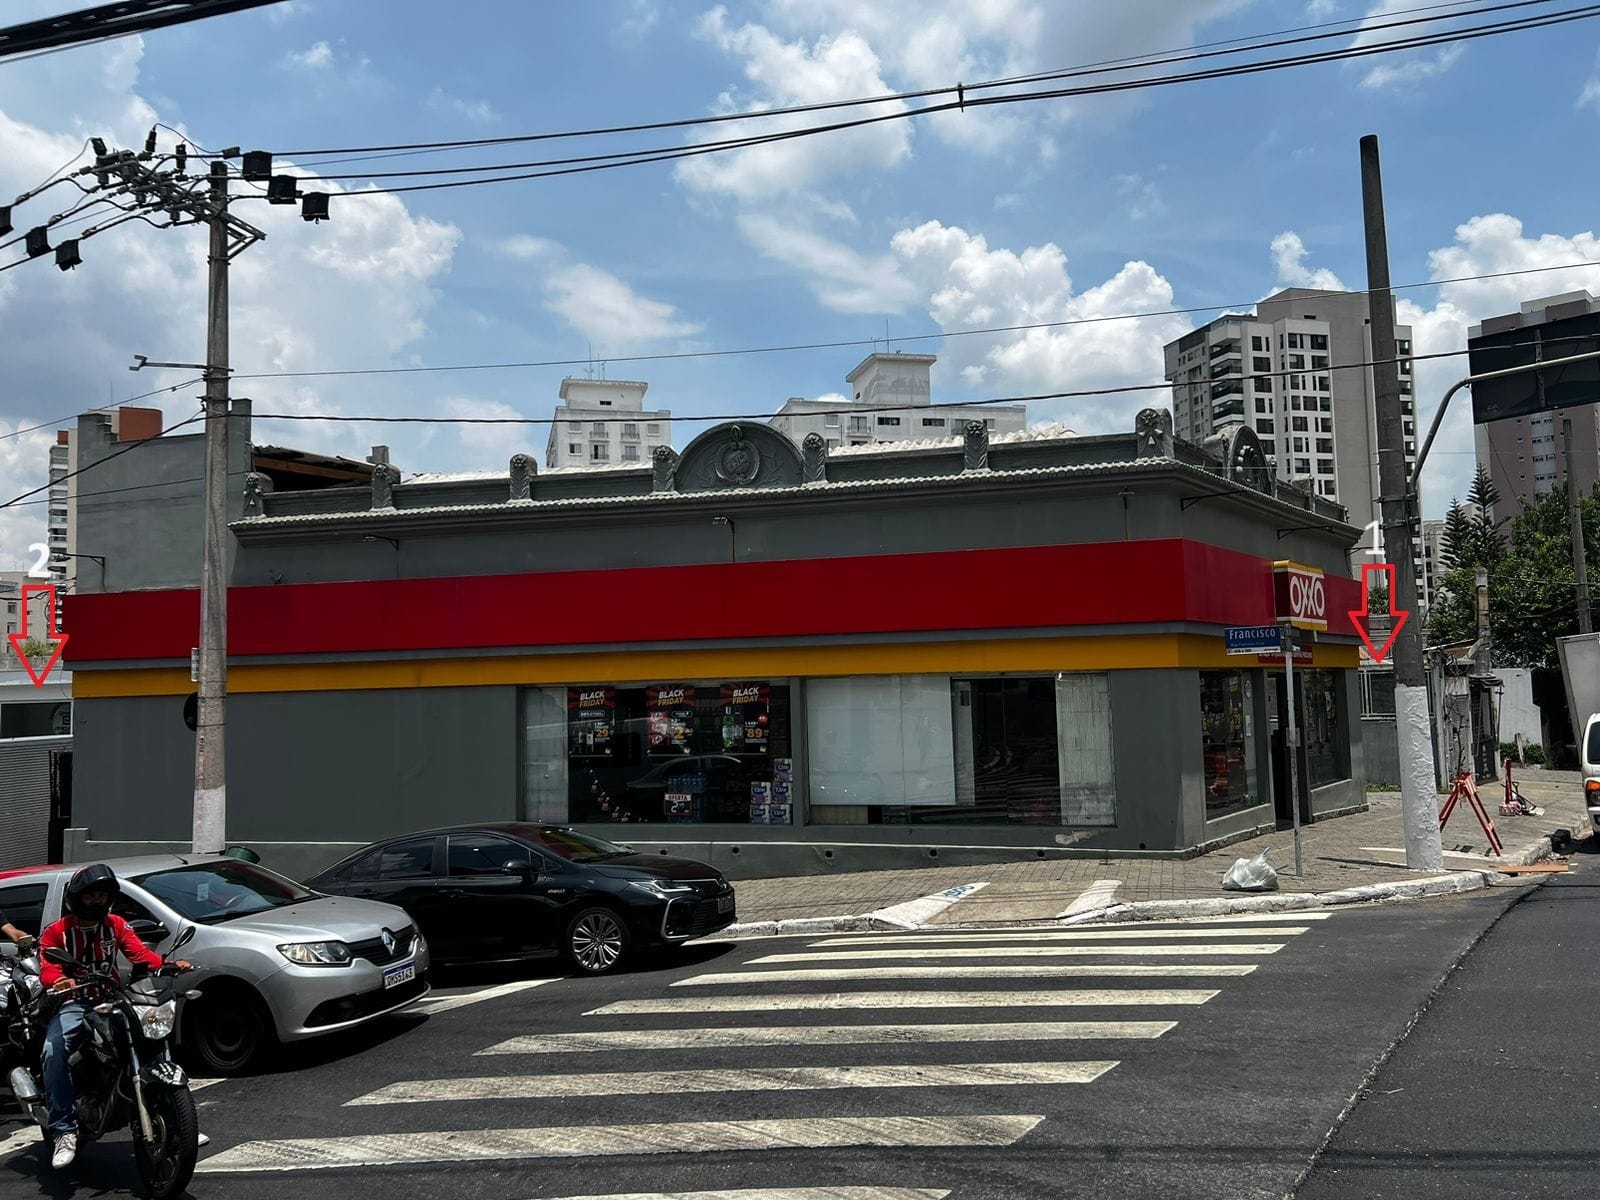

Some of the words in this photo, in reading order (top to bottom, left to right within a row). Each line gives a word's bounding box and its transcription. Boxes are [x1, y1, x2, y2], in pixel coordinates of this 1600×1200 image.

[1290, 575, 1325, 618] OXXO
[1229, 628, 1276, 640] Francisco
[579, 690, 606, 700] BLACK
[658, 689, 685, 699] BLACK
[733, 687, 760, 697] BLACK
[579, 698, 606, 708] FRIDAY
[657, 697, 684, 707] FRIDAY
[732, 695, 760, 705] FRIDAY
